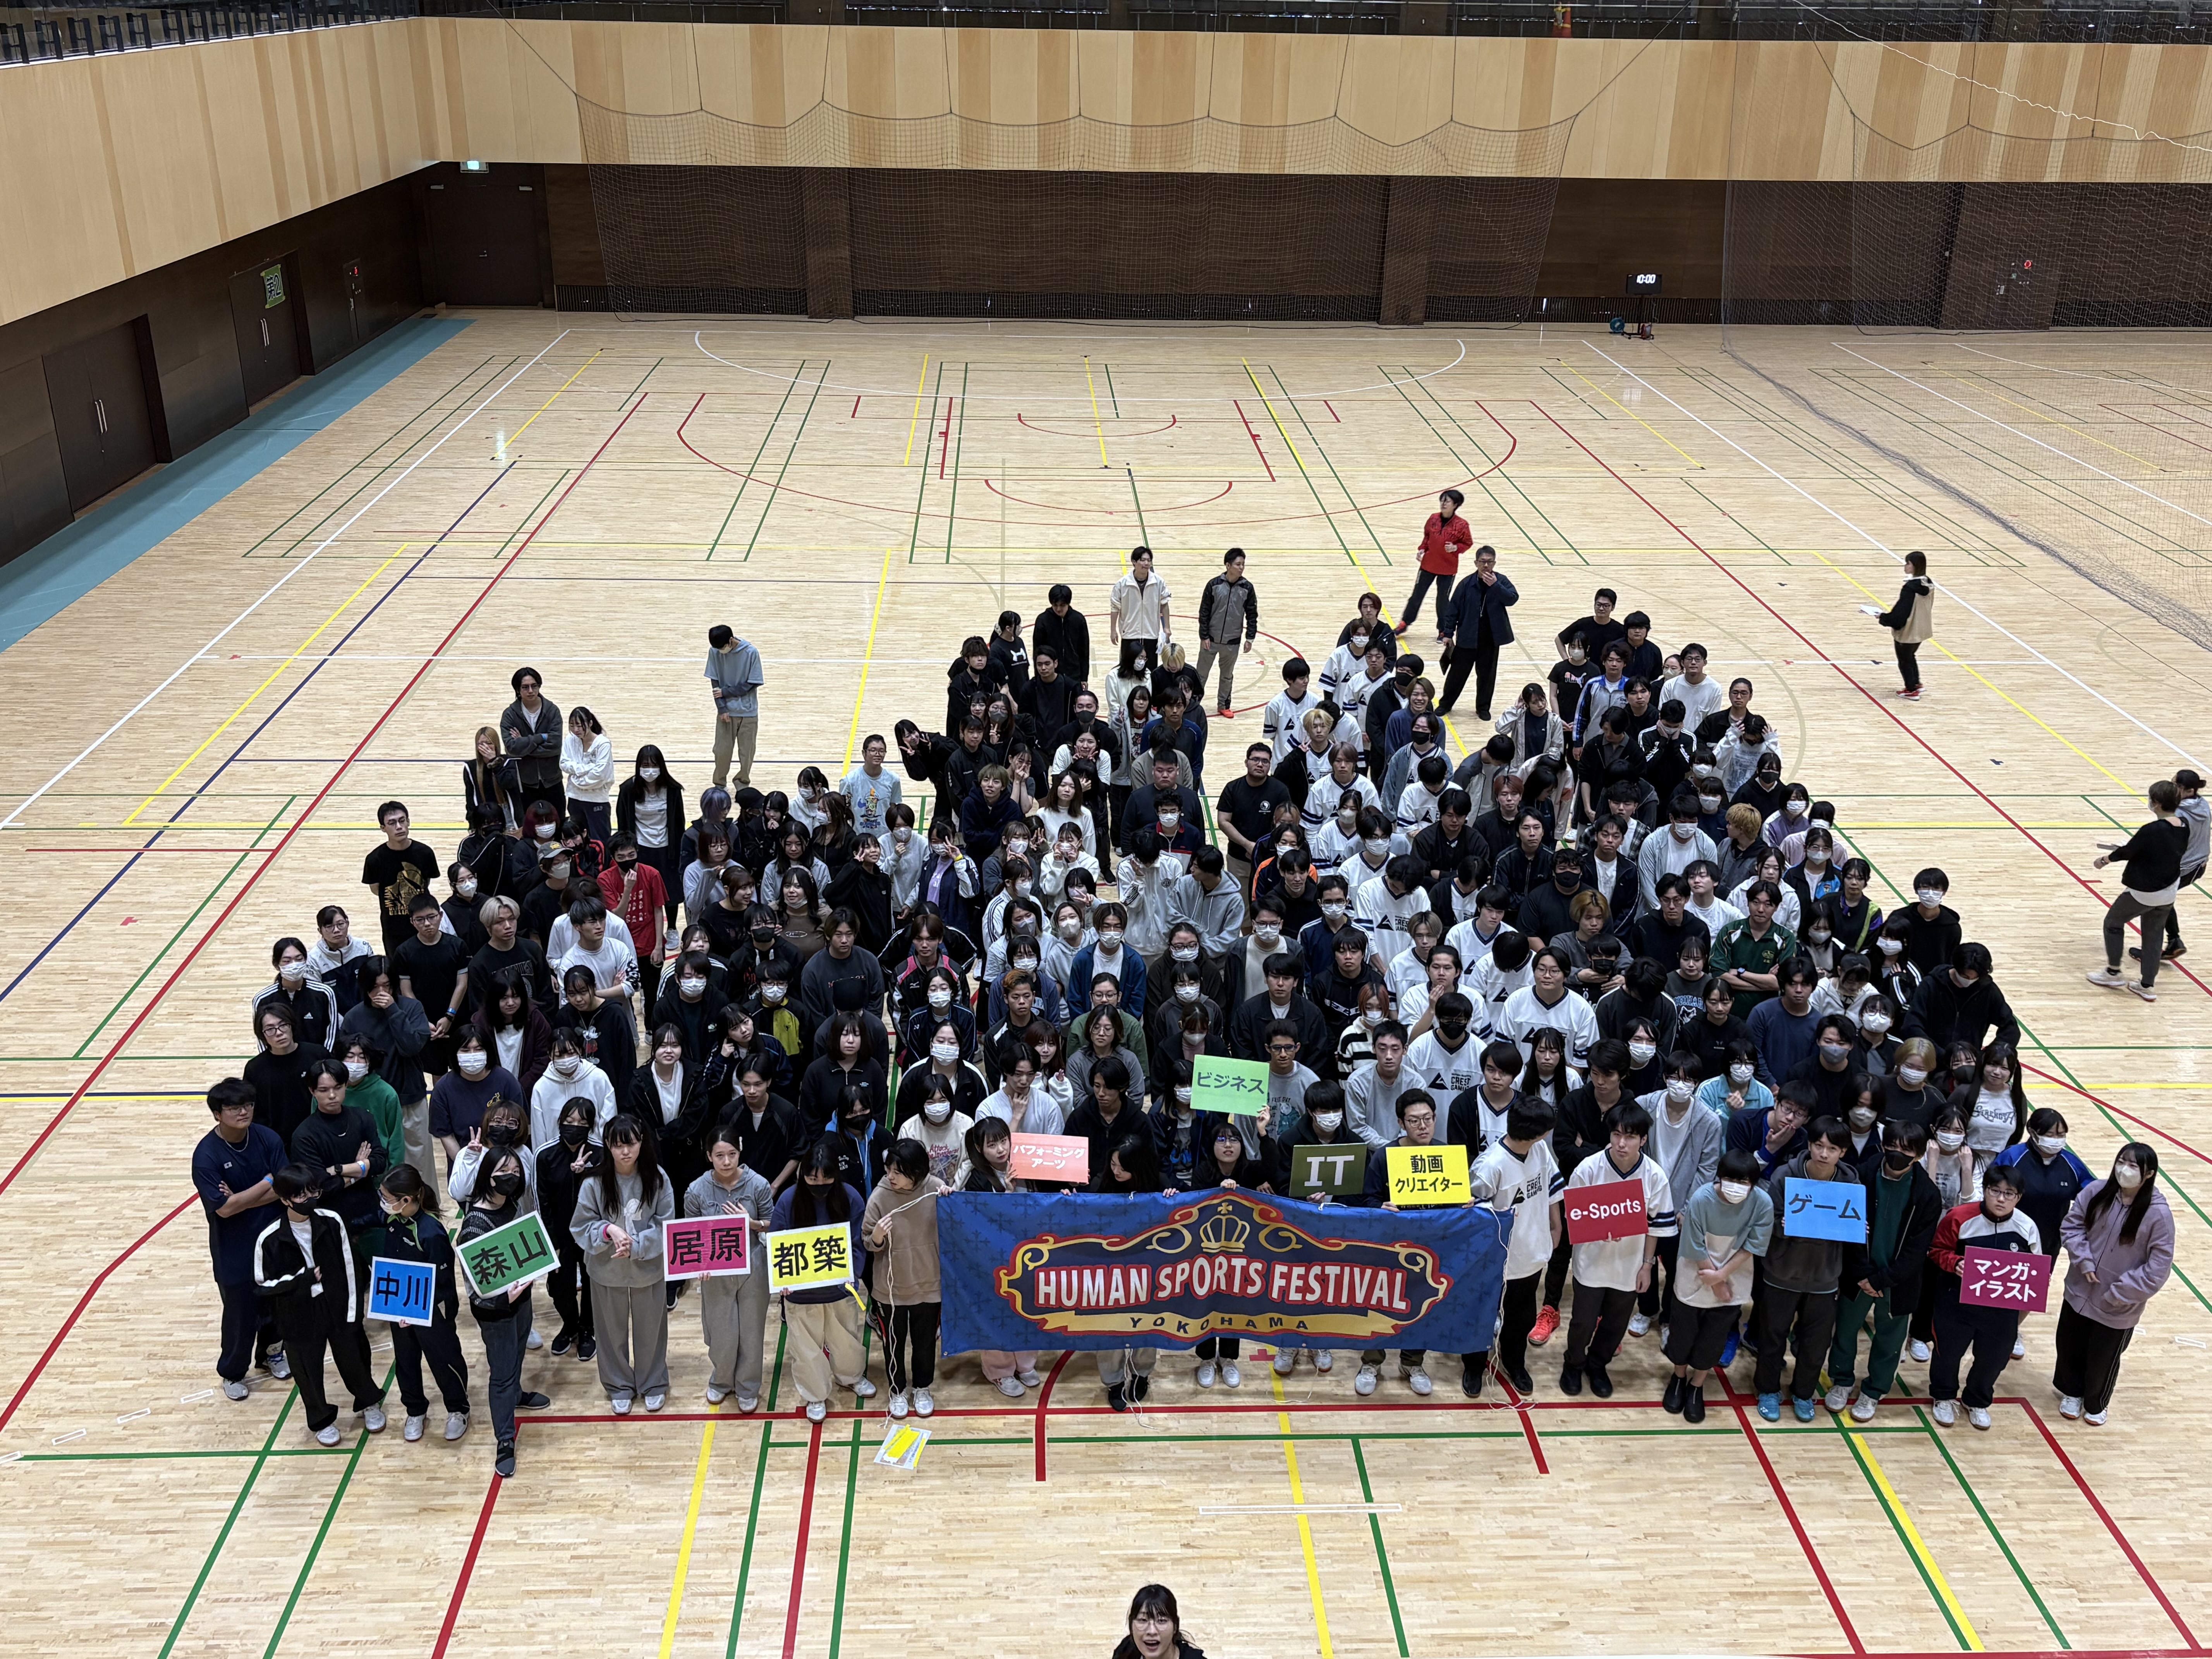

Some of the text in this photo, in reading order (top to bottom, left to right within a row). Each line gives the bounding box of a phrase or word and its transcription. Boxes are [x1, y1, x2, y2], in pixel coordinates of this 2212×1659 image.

[266, 273, 282, 301] 第2
[1637, 274, 1656, 284] 10:00
[1197, 1072, 1264, 1094] ビジネス
[1451, 1077, 1471, 1086] CREST
[1013, 1144, 1085, 1159] パフォーミング
[1031, 1158, 1065, 1169] アーツ
[1304, 1155, 1355, 1186] IT
[1410, 1154, 1443, 1173] 動画
[1395, 1176, 1463, 1194] クリエイター
[1570, 1199, 1641, 1220] e-Sports
[1788, 1193, 1861, 1221] ゲーム
[670, 1226, 743, 1266] 居原
[773, 1235, 847, 1278] 都築
[470, 1231, 548, 1285] 森山
[1974, 1259, 2037, 1280] マンガ・
[376, 1271, 429, 1310] 中川
[1039, 1255, 1407, 1310] HUMAN SPORTS FESTIVAL
[1969, 1279, 2037, 1302] イラスト
[1130, 1317, 1308, 1334] YOKOHAMA
